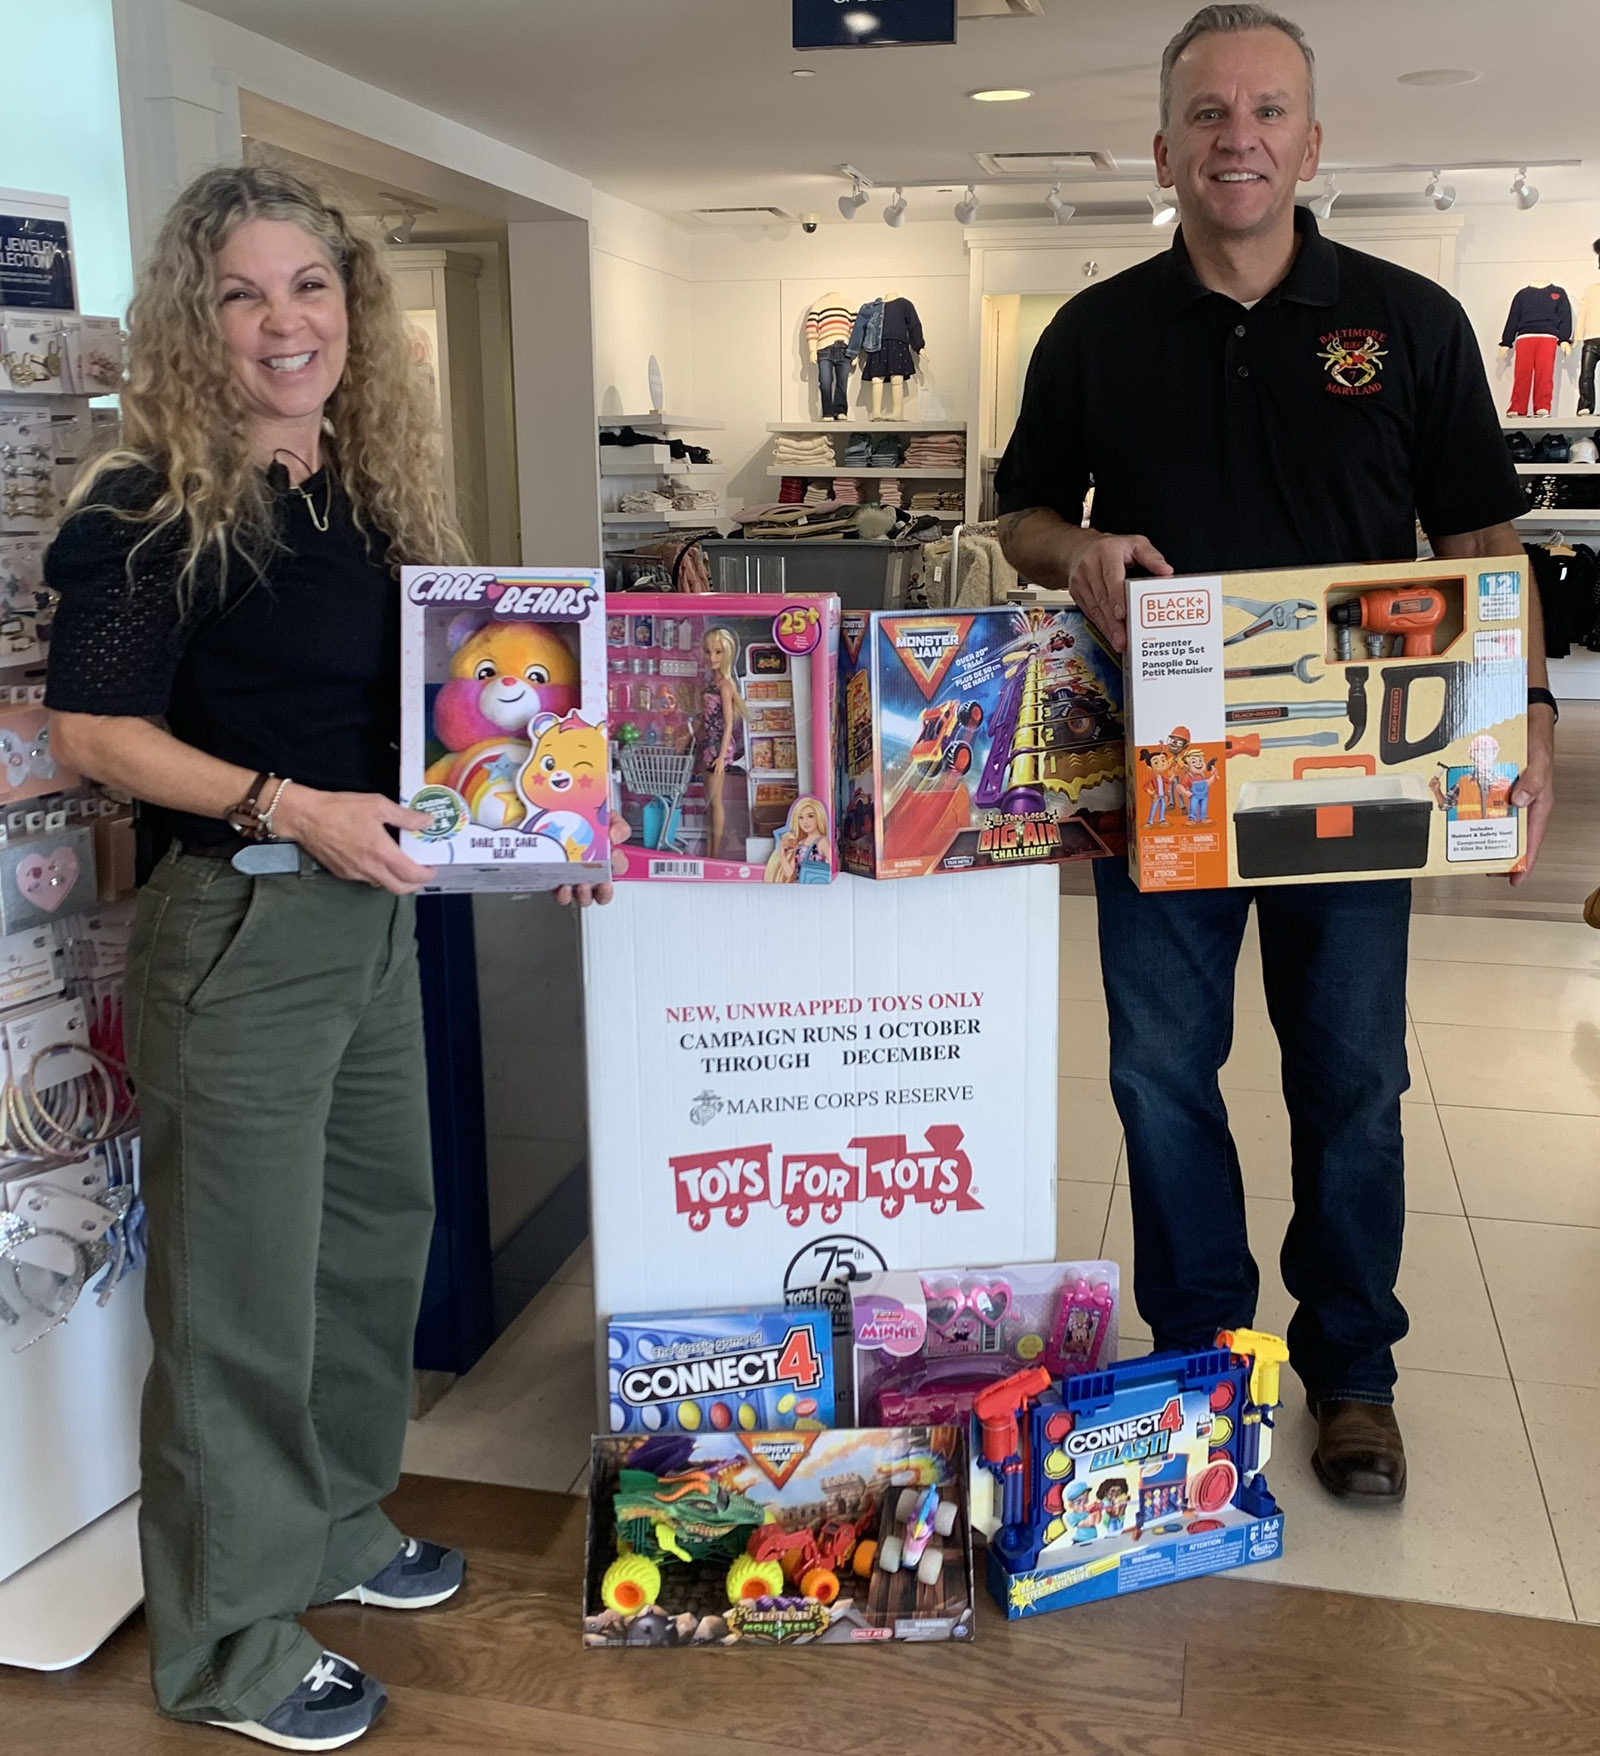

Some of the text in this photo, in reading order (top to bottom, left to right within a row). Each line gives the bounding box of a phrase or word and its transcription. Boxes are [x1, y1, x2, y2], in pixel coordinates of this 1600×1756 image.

[5, 237, 58, 253] JEWELRY
[1319, 328, 1387, 344] BALTIMORE
[1349, 371, 1357, 380] 7
[1325, 382, 1382, 396] MARYLAND
[1486, 574, 1513, 595] 12
[410, 573, 596, 615] CARE BEARS
[1147, 597, 1203, 610] BLACK+
[780, 607, 820, 636] 25+
[1147, 608, 1205, 623] DECKER
[896, 635, 959, 648] MONSTER
[1142, 640, 1192, 649] Carpenter
[914, 646, 942, 658] JAM
[1172, 648, 1186, 656] Up
[1188, 646, 1205, 654] Set
[955, 654, 976, 667] OVER
[1142, 658, 1199, 669] Panoplie Du
[955, 674, 974, 687] PLUS
[974, 669, 984, 678] DE
[983, 665, 993, 675] 50
[1142, 666, 1213, 677] Petit Menuisier
[963, 681, 973, 691] DE
[973, 674, 992, 686] HAUT
[1044, 707, 1052, 717] 3
[1045, 728, 1055, 741] 2
[1004, 813, 1024, 821] Toro
[1024, 811, 1045, 820] Loco
[471, 837, 538, 848] DARE TO CARE
[979, 821, 1060, 851] BIG AIR
[493, 849, 516, 859] BEAR
[993, 846, 1049, 859] CHALLENGE
[666, 991, 984, 1024] NEW, UNWRAPPED TOYS ONLY
[679, 1018, 981, 1050] CAMPAIGN RUNS 1 OCTOBER
[700, 1044, 961, 1073] THROUGH DECEMBER
[726, 1084, 974, 1116] MARINE CORPS RESERVE
[678, 1156, 959, 1203] TOYS FOR TOTS
[786, 1288, 844, 1306] TOYS FOR
[858, 1321, 919, 1340] MINNIE
[623, 1349, 780, 1402] CONNECT
[1069, 1413, 1161, 1455] CONNECT
[752, 1444, 804, 1454] MONSTER
[768, 1453, 791, 1461] JAM
[1189, 1539, 1221, 1551] ATTENTION
[742, 1621, 816, 1633] MONSTERS
